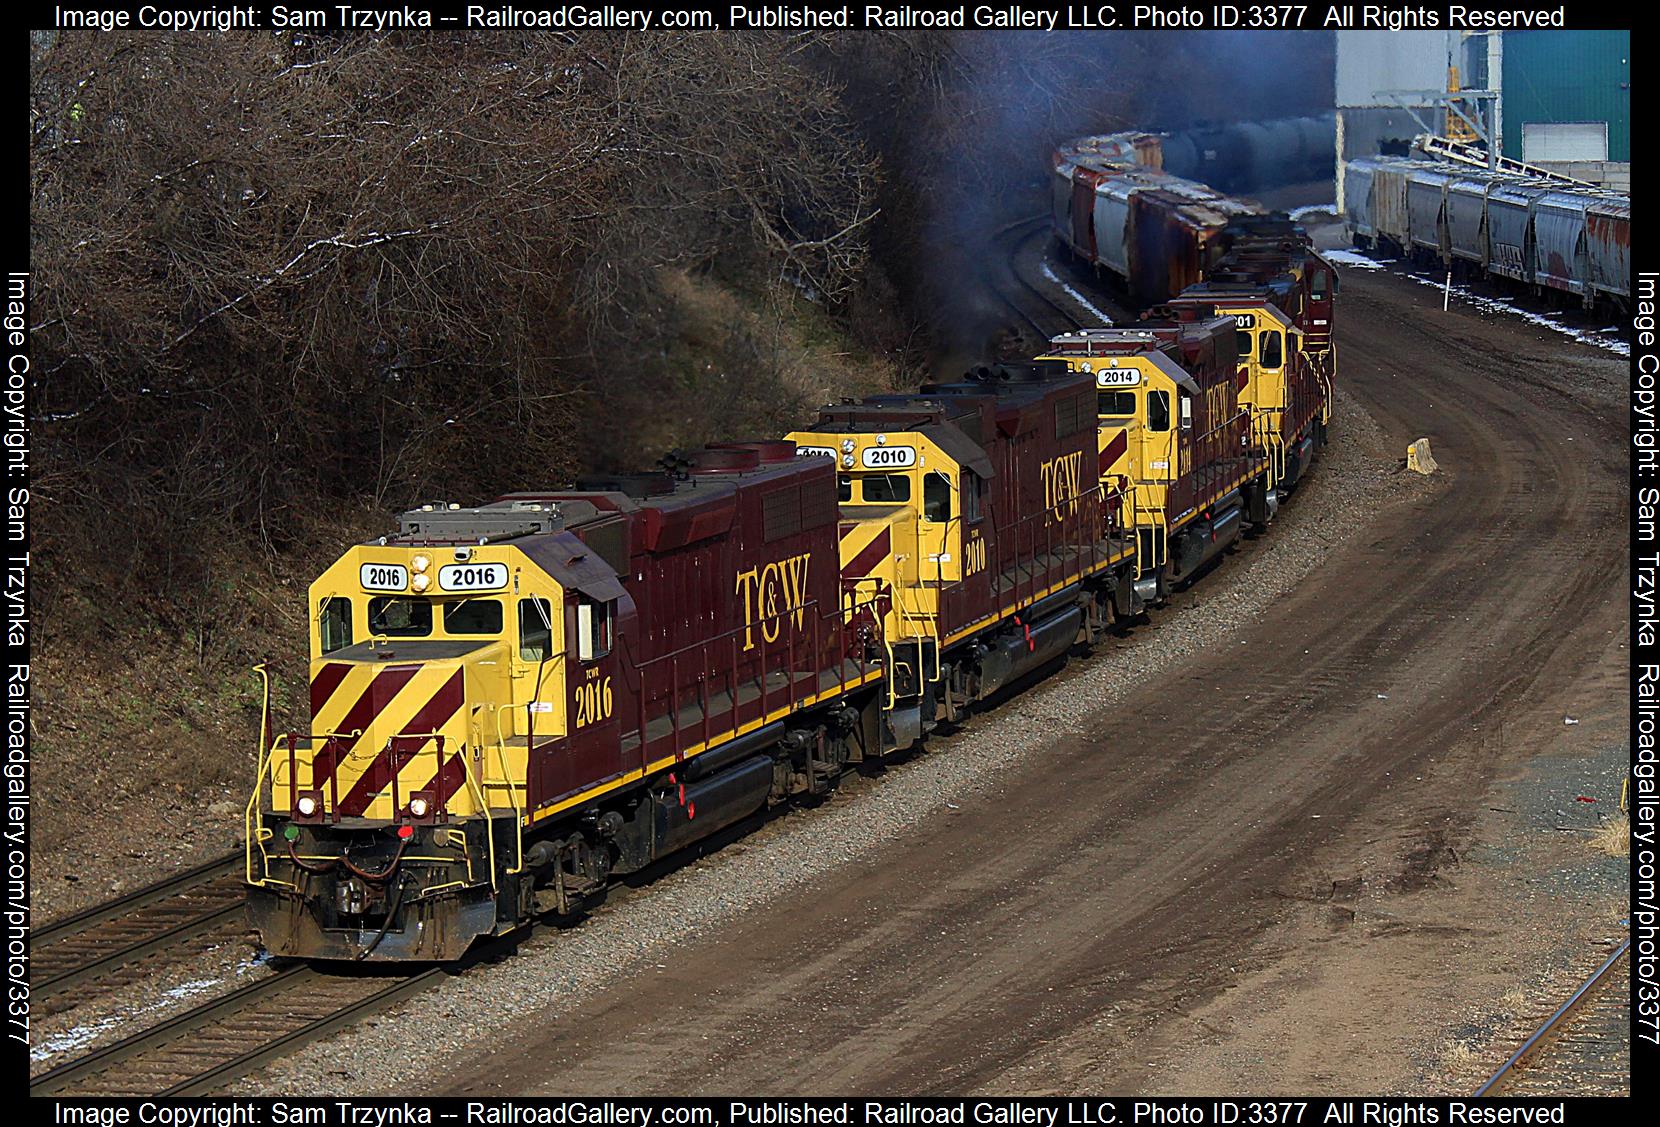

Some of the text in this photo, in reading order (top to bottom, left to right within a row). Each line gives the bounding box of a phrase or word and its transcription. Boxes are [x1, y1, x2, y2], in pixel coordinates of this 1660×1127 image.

[1104, 371, 1133, 383] 2014
[871, 450, 907, 464] 2010
[965, 537, 986, 577] 2010
[370, 568, 400, 586] 2016
[452, 568, 496, 586] 2016
[575, 676, 613, 729] 2016
